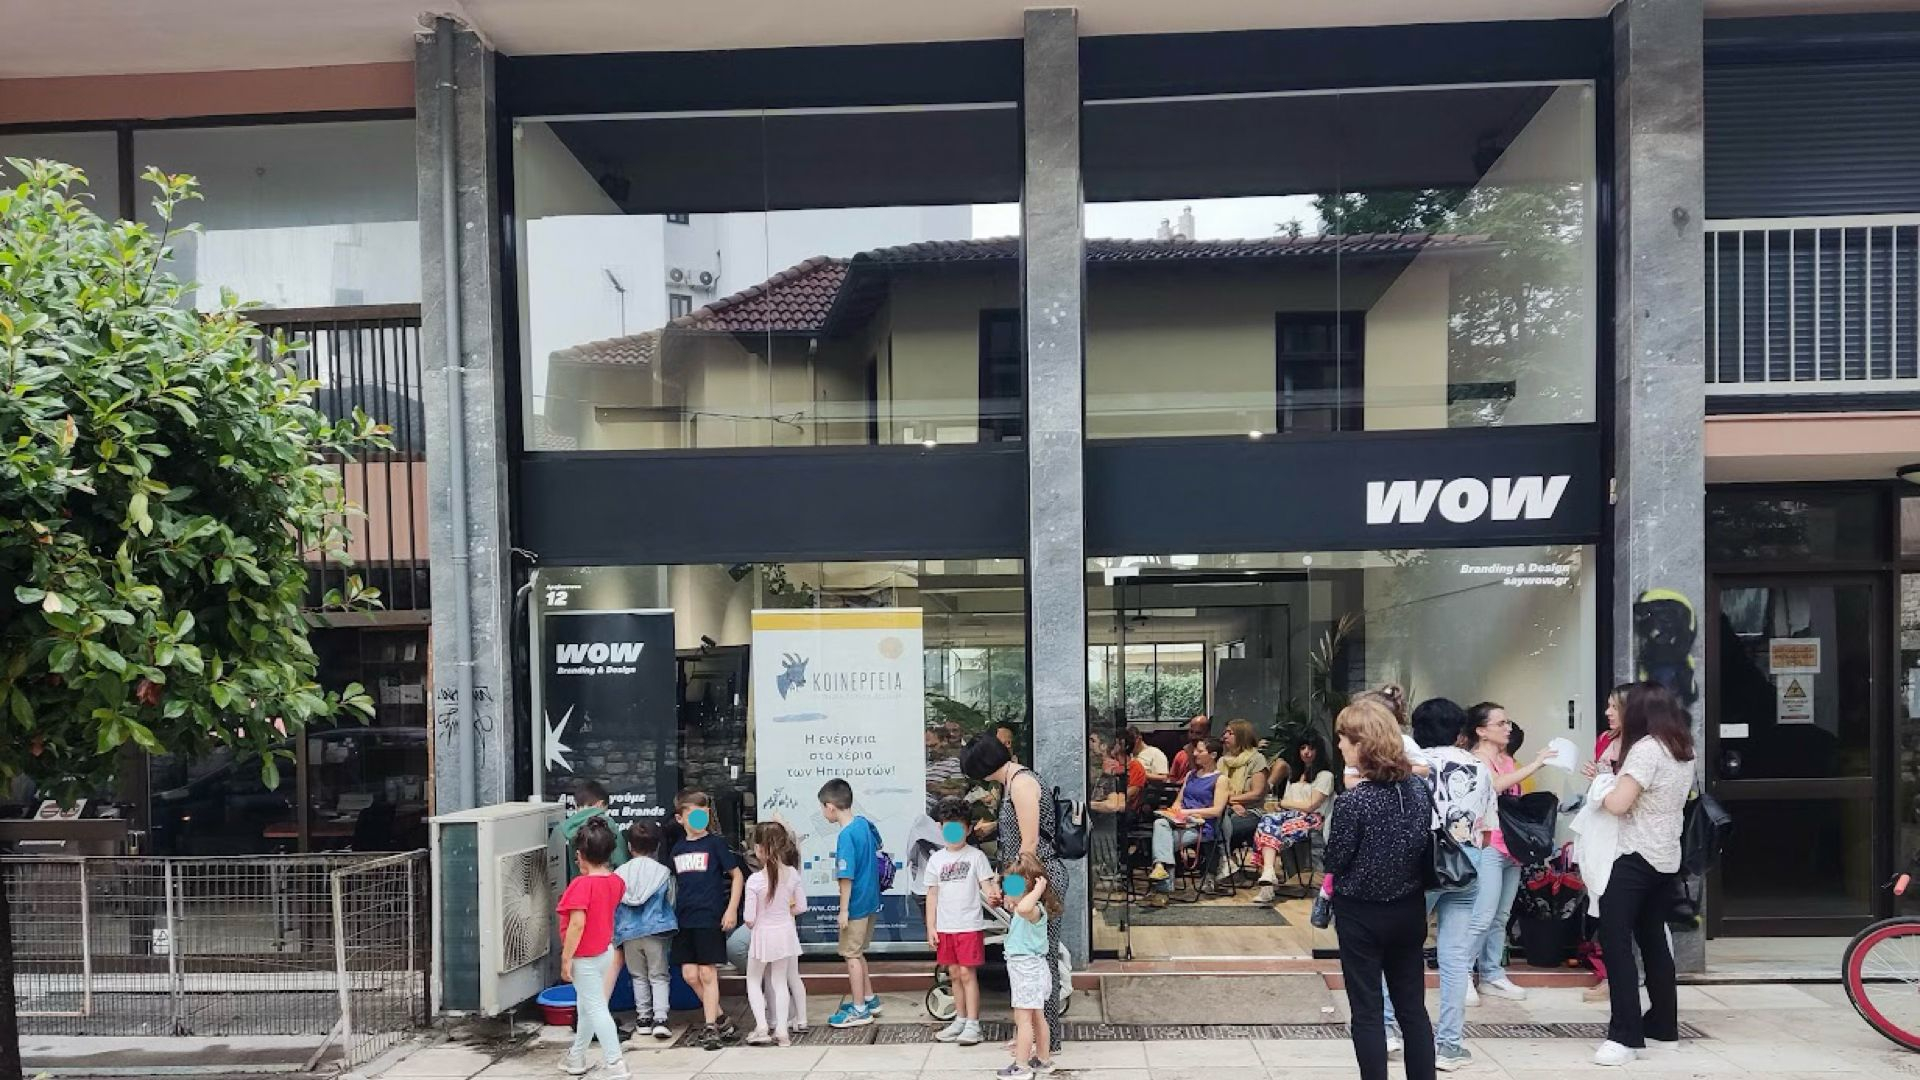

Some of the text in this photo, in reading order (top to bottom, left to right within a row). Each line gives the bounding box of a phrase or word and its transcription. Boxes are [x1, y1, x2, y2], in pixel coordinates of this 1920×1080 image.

[1366, 475, 1571, 525] WOW
[1460, 562, 1570, 575] Branding & Design
[1503, 577, 1570, 588] saywow.gr
[545, 591, 568, 606] 12
[556, 643, 645, 664] WOW
[556, 665, 637, 676] Branding & Design
[812, 671, 902, 692] ΚΟΙΝΕΡΓΕΙΑ
[805, 732, 877, 746] Η ενέργεια
[809, 748, 872, 762] στα χέρια
[787, 764, 896, 778] των Ηπειρωτών!
[621, 806, 666, 817] Brands
